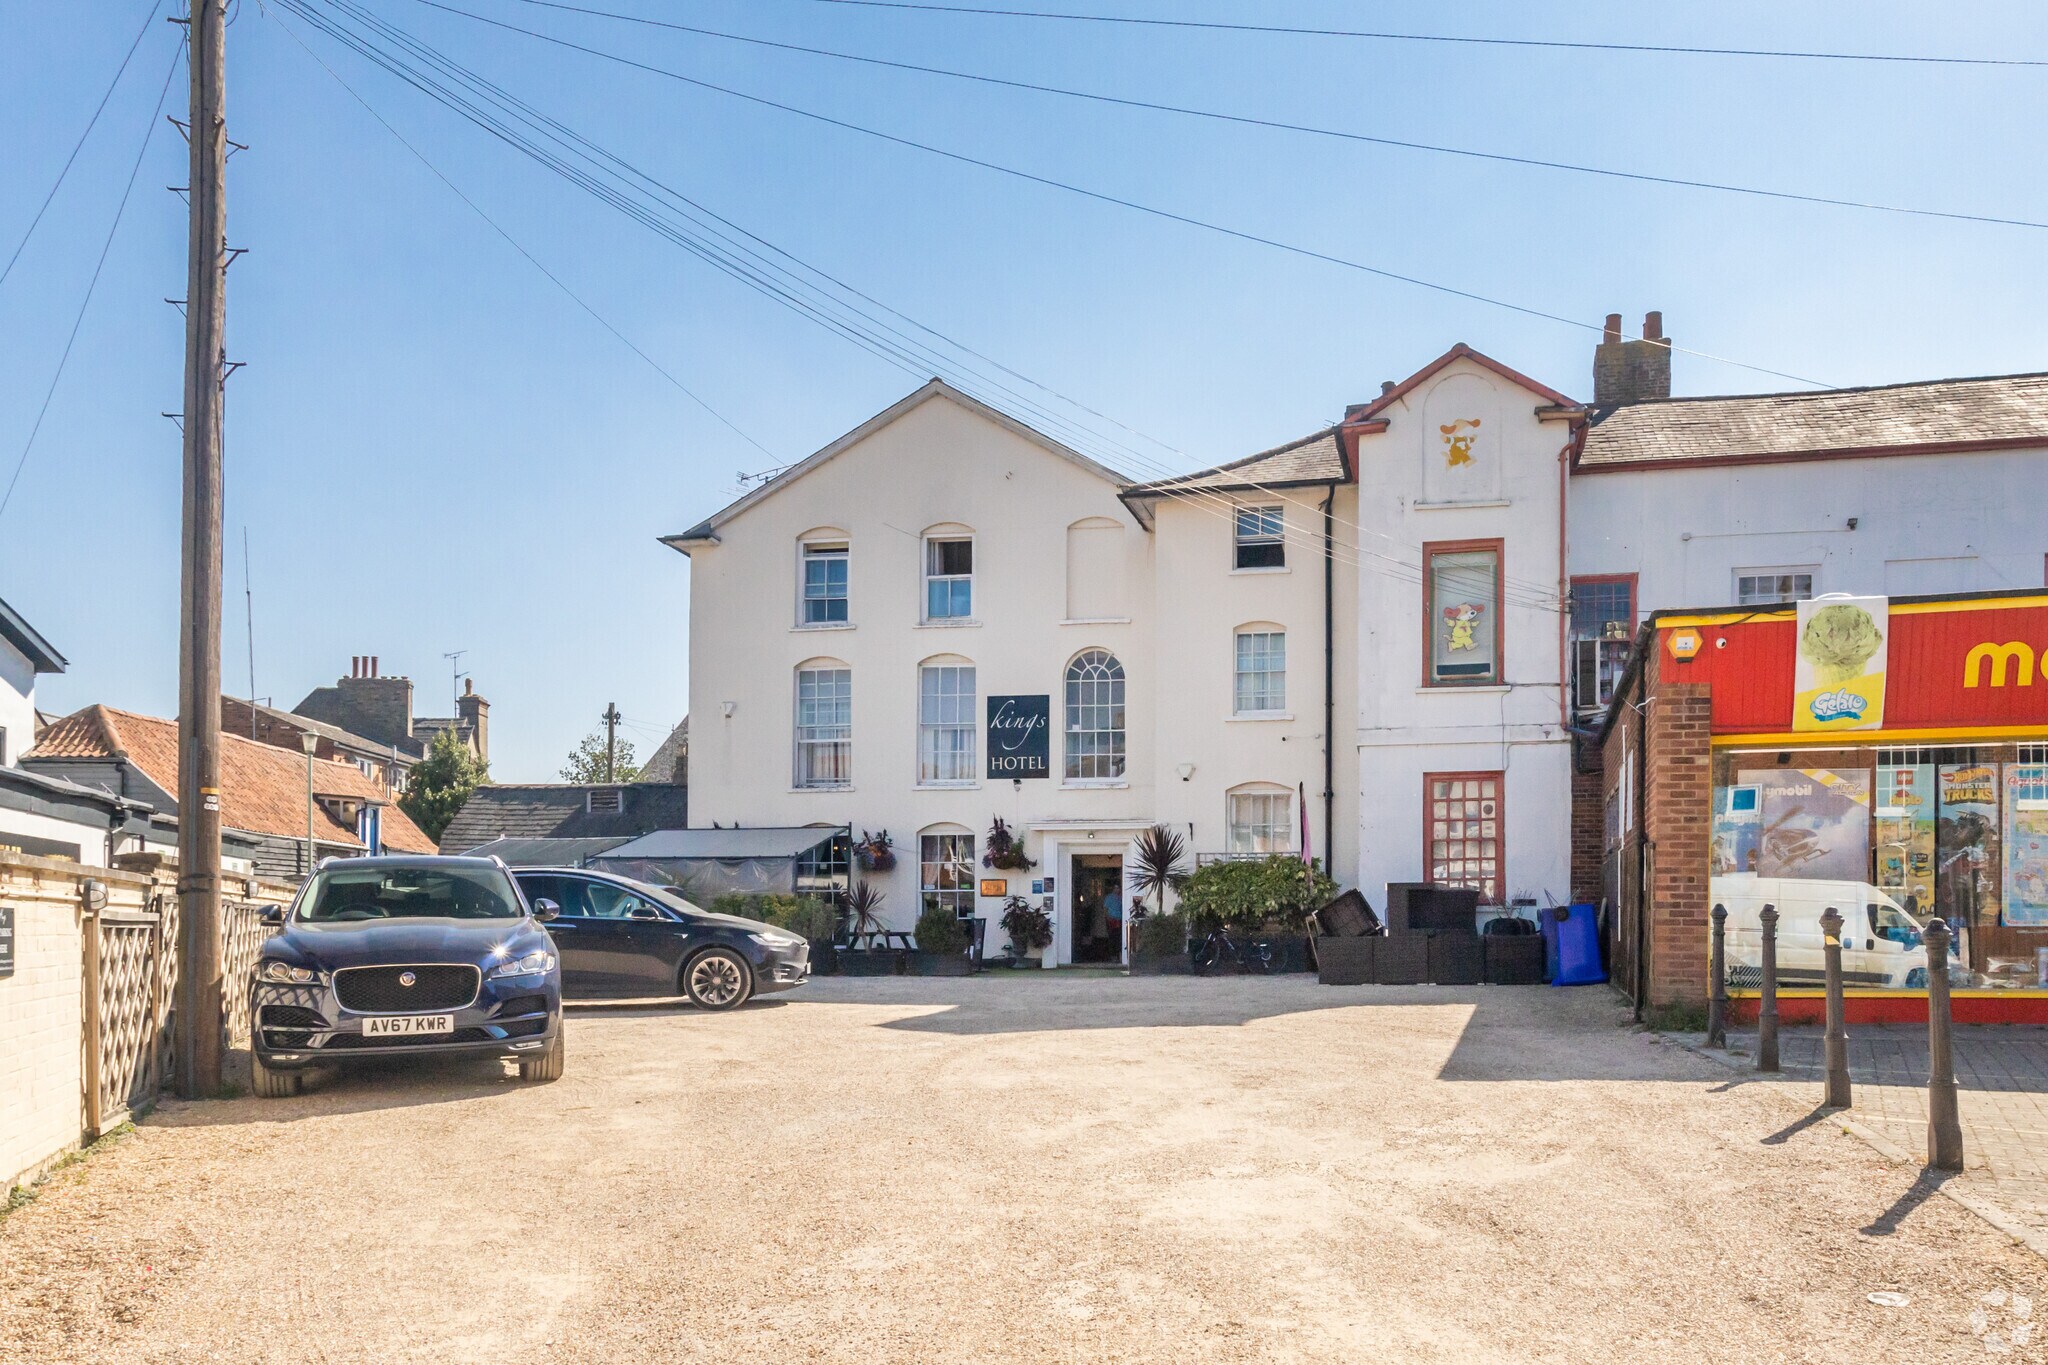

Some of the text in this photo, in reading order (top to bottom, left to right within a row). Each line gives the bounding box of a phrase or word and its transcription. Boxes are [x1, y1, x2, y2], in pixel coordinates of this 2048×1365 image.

[1964, 641, 2048, 688] m
[1815, 688, 1863, 714] Gelato
[989, 700, 1046, 750] kings
[992, 757, 1045, 770] HOTEL
[1765, 784, 1812, 798] ymobil
[1945, 789, 1993, 801] TRUCKS
[370, 1017, 446, 1032] AV67 KWR
